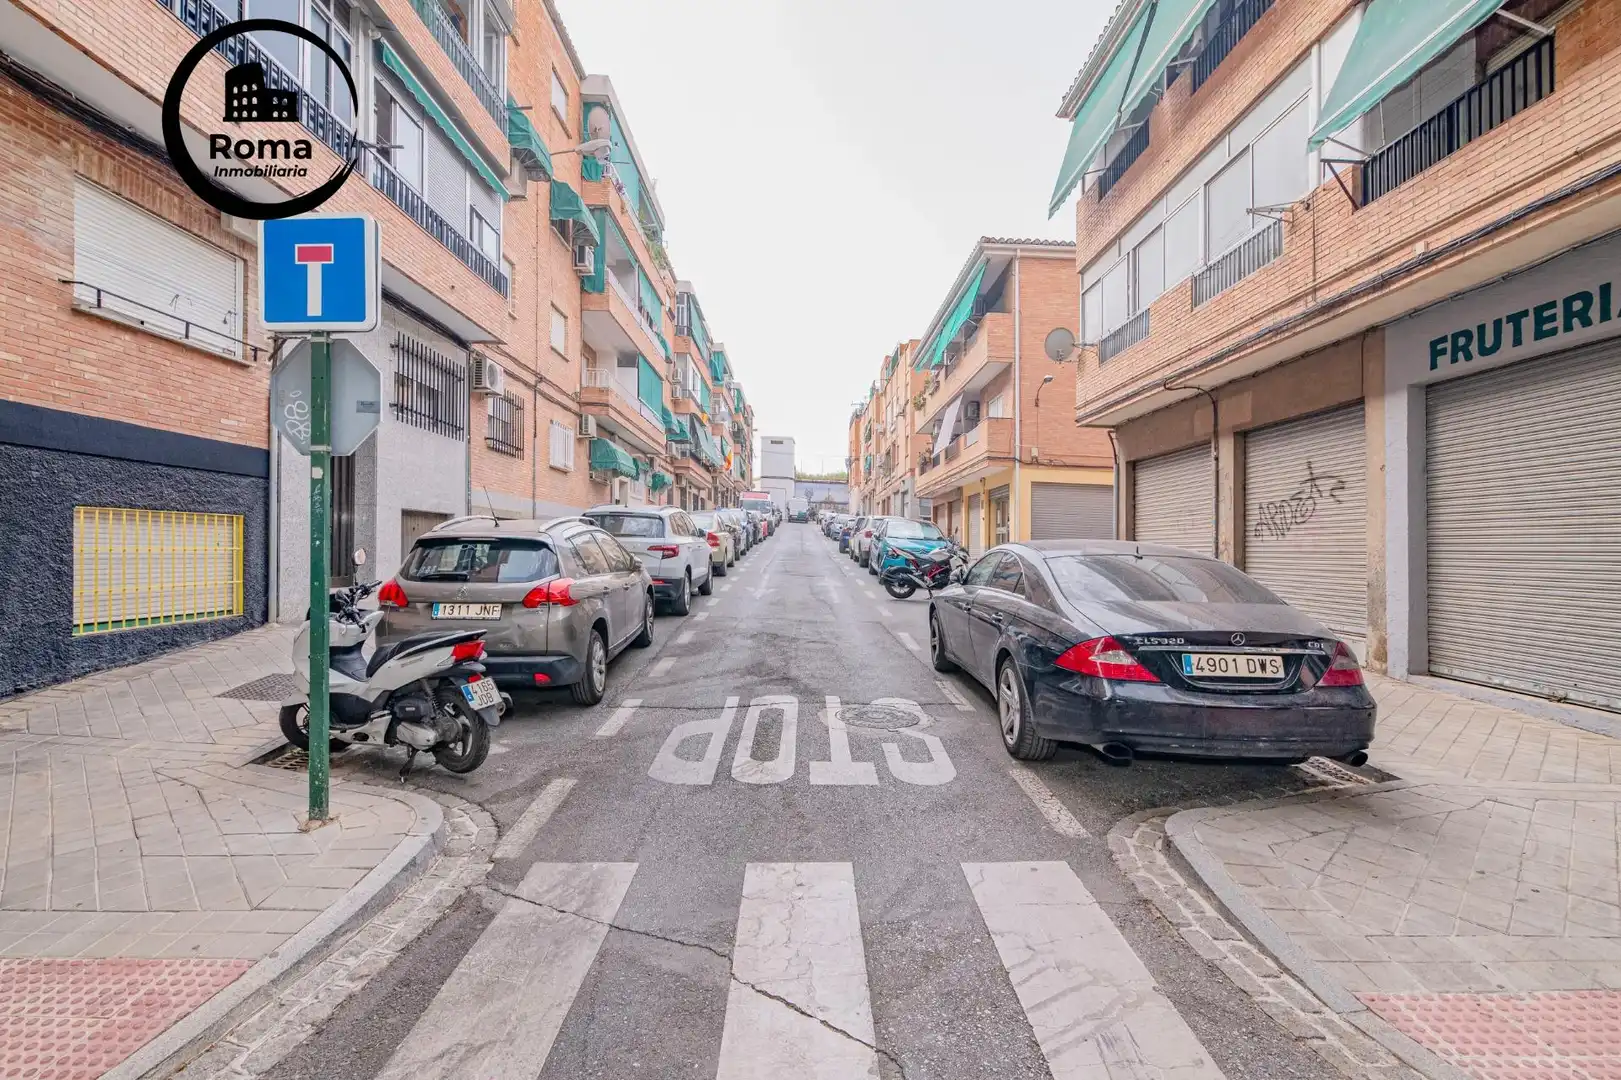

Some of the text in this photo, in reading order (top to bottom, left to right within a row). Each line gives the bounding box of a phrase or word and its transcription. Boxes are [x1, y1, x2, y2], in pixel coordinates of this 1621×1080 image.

[1429, 282, 1621, 371] FRUTERI
[442, 605, 499, 616] 1311 JNF
[1195, 656, 1280, 675] 4901 DWS
[471, 680, 494, 696] 4165
[647, 695, 958, 786] STOP
